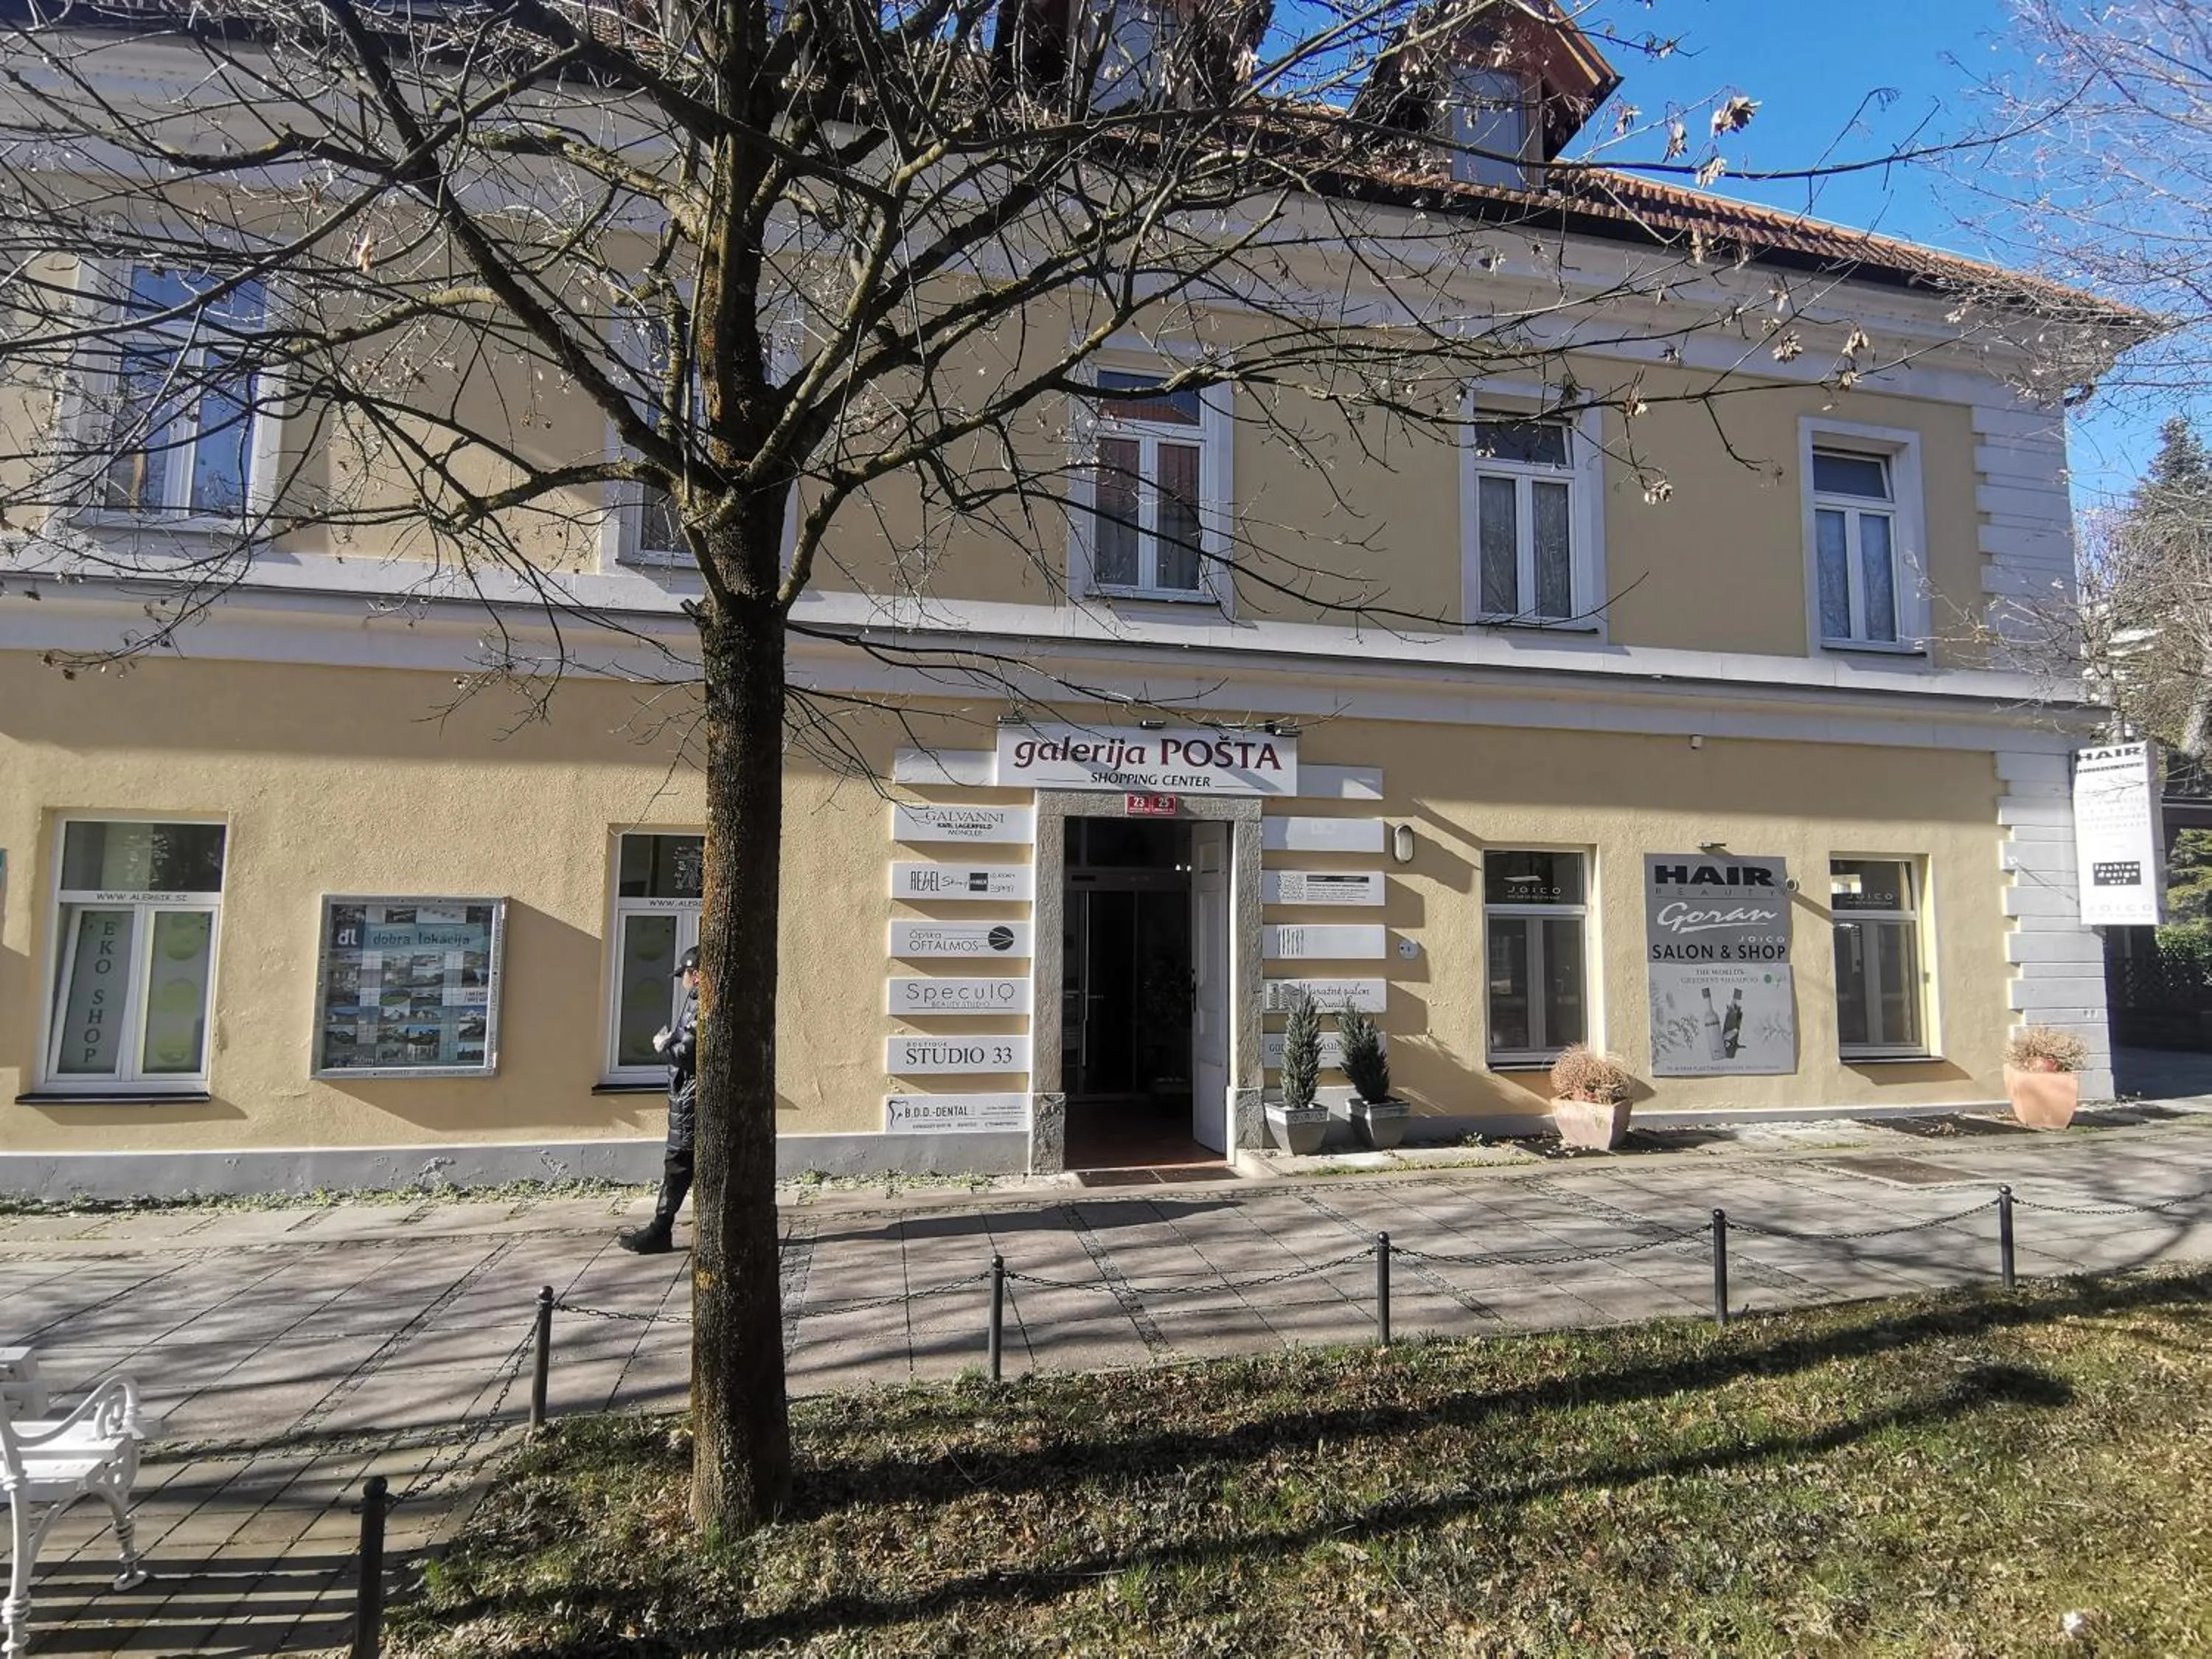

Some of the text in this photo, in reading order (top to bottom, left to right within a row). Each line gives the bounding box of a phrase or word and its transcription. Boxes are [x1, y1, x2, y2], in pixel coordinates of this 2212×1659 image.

[1015, 734, 1282, 771] galerija POŠTA
[2074, 747, 2141, 762] HAIR
[1091, 772, 1210, 787] SHOPPING CENTER
[926, 811, 1004, 823] GALVANNI
[1655, 865, 1775, 887] HAIR
[1507, 886, 1562, 894] JOICO
[1657, 902, 1778, 933] Goran
[338, 928, 470, 947] dl dobra lokacija
[909, 940, 979, 951] OFTALMOS
[1739, 935, 1785, 944] JOICO
[95, 922, 116, 974] EKO
[1652, 944, 1786, 960] SALON & SHOP
[83, 989, 105, 1062] SHOP
[905, 1047, 1012, 1065] STUDIO 33
